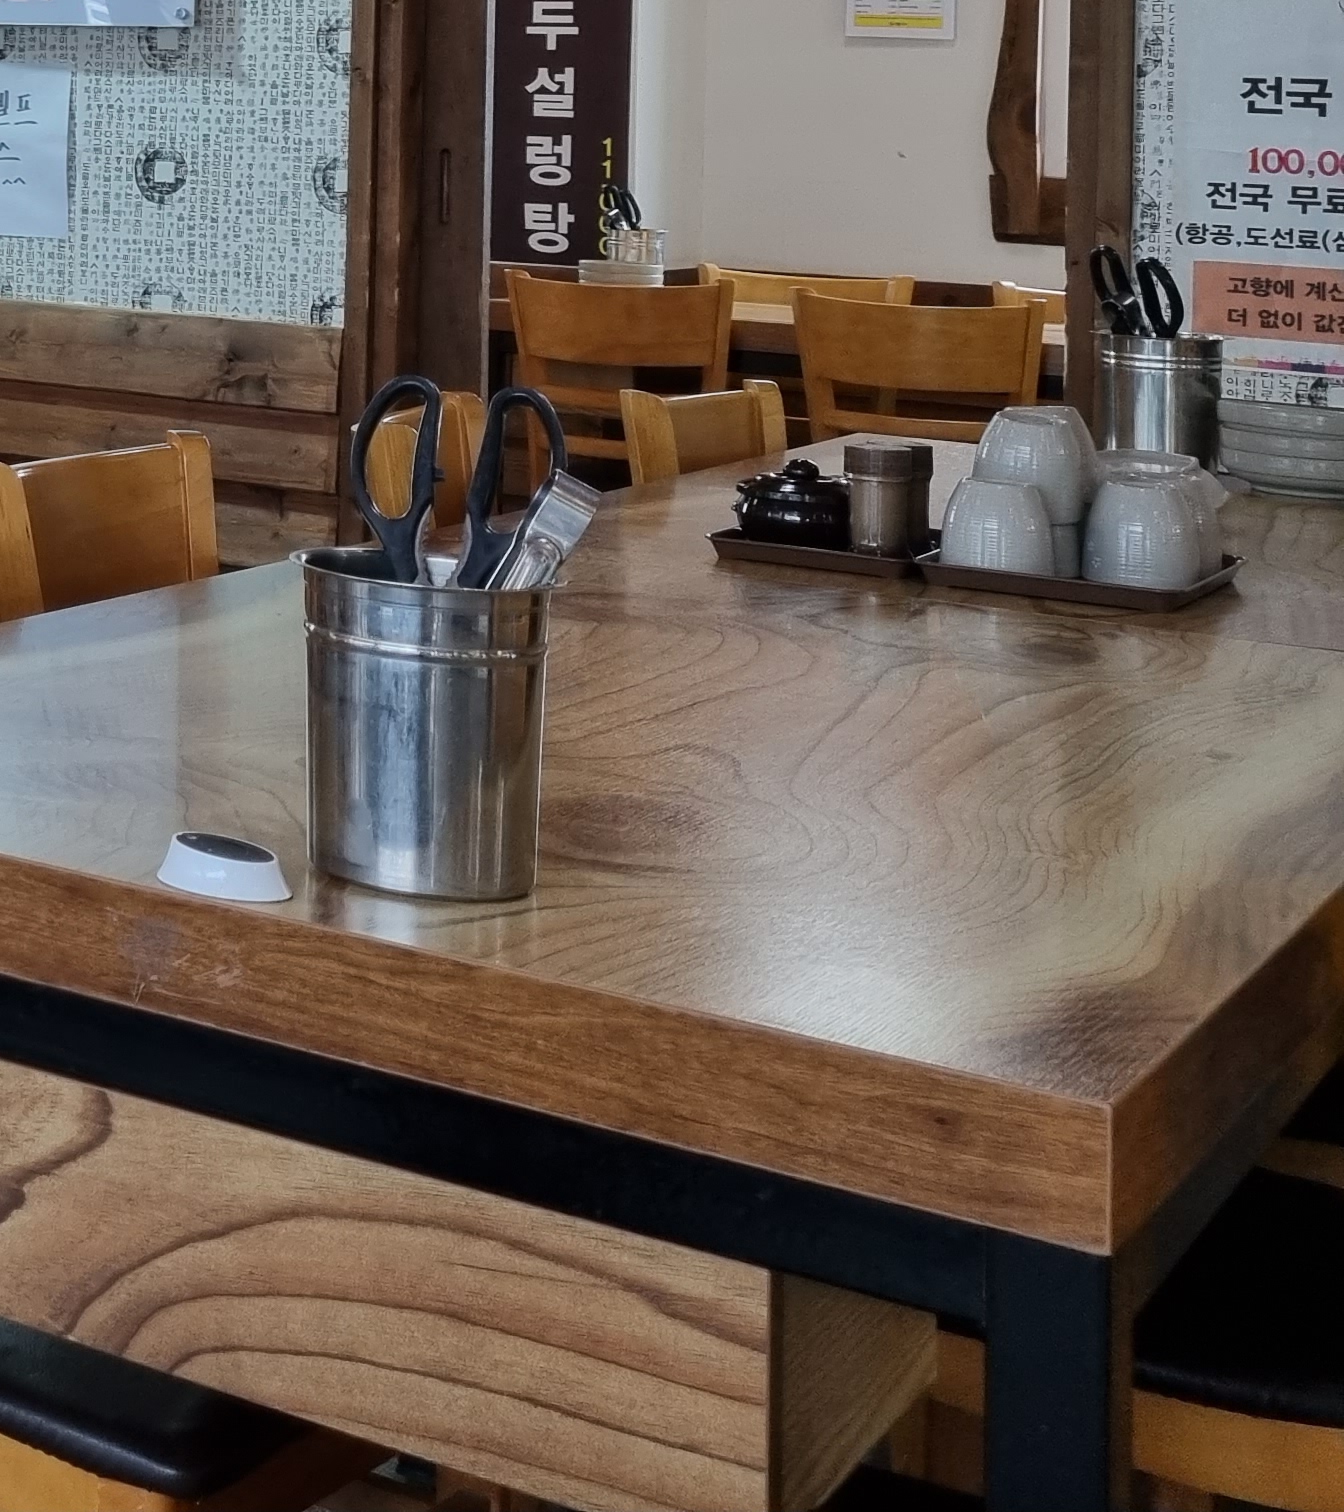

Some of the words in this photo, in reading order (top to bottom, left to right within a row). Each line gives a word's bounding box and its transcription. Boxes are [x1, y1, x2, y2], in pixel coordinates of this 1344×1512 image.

[1240, 76, 1333, 117] 전국
[1248, 147, 1344, 178] 100,0
[1206, 182, 1273, 212] 전국
[1227, 277, 1294, 299] 고향에
[1227, 308, 1247, 327] 더
[1258, 309, 1302, 331] 없이
